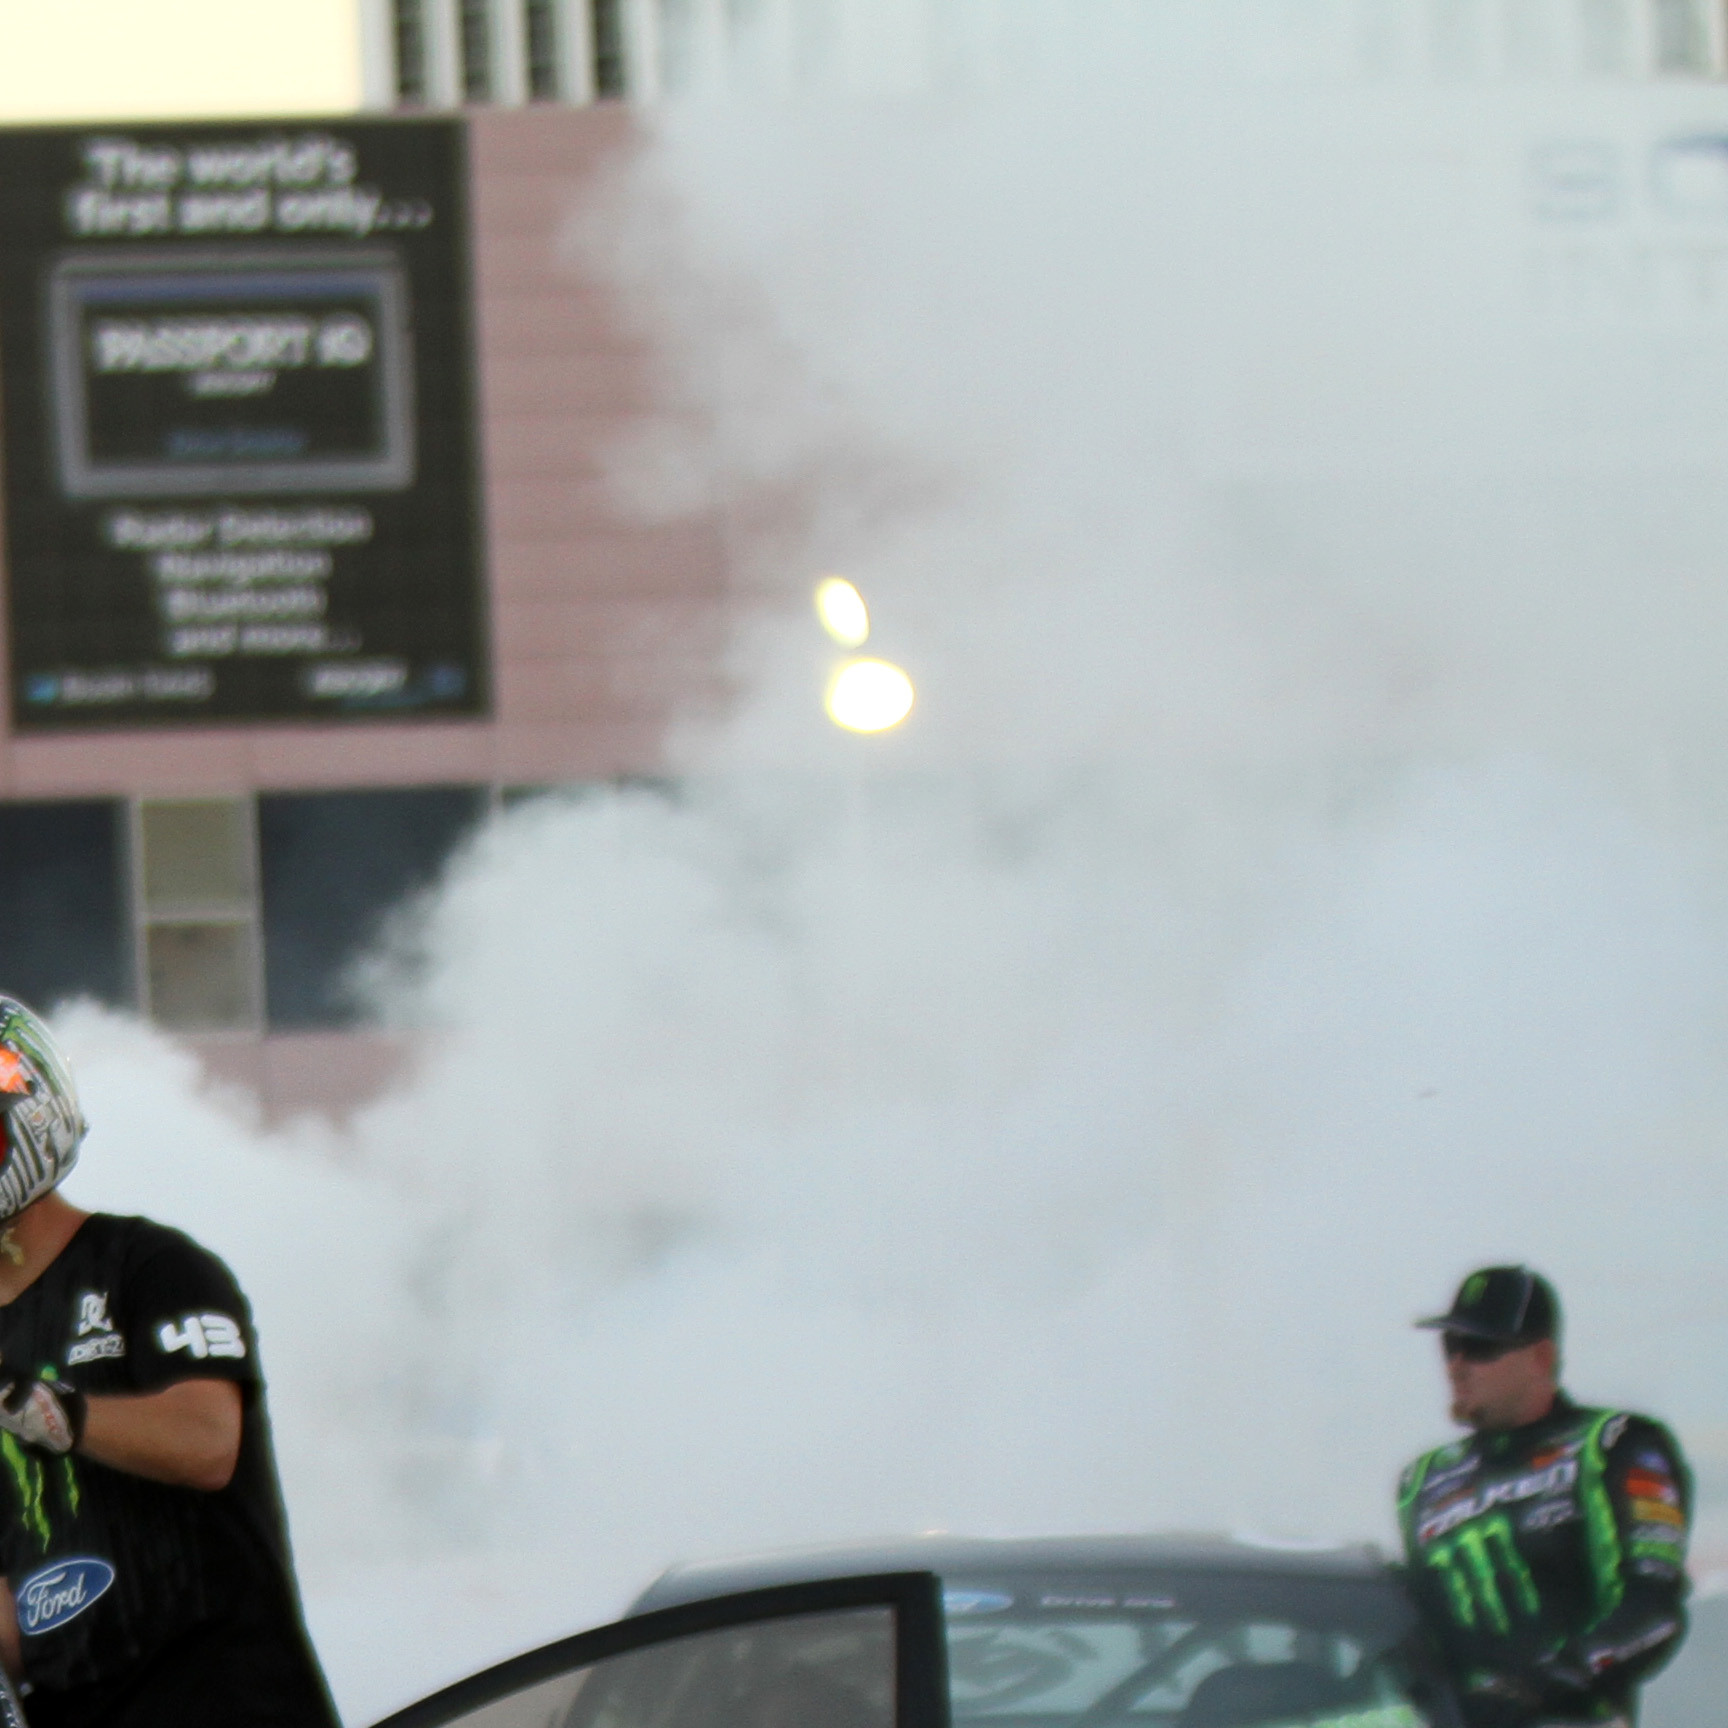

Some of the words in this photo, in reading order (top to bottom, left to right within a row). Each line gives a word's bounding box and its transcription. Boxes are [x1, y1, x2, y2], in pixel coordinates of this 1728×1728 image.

[87, 138, 178, 188] The
[178, 188, 271, 233] and
[160, 1314, 245, 1358] 43
[27, 1572, 87, 1627] Ford
